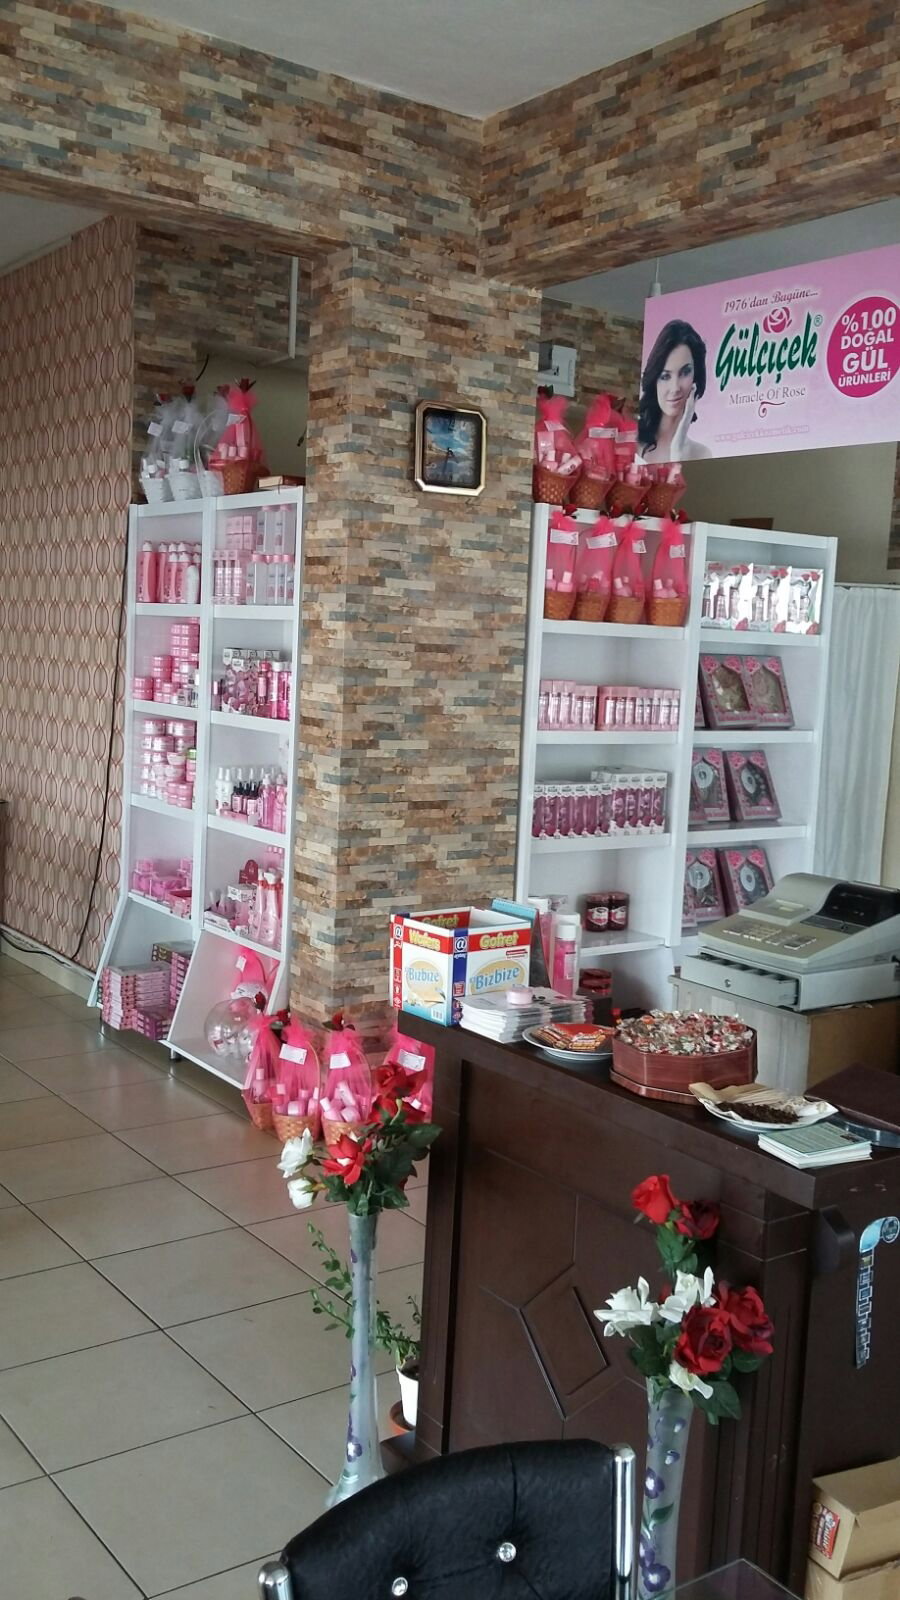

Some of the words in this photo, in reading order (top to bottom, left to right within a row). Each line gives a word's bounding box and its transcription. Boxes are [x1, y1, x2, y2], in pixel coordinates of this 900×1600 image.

[841, 306, 897, 334] %100
[840, 327, 895, 350] DOĞAL
[842, 345, 889, 374] GÜL
[838, 367, 892, 388] ÜRÜNLERİ
[766, 387, 780, 400] Of
[782, 386, 806, 399] Rose
[480, 931, 520, 950] Gofret
[409, 967, 440, 982] Bizbize
[475, 967, 520, 990] Bizbize
